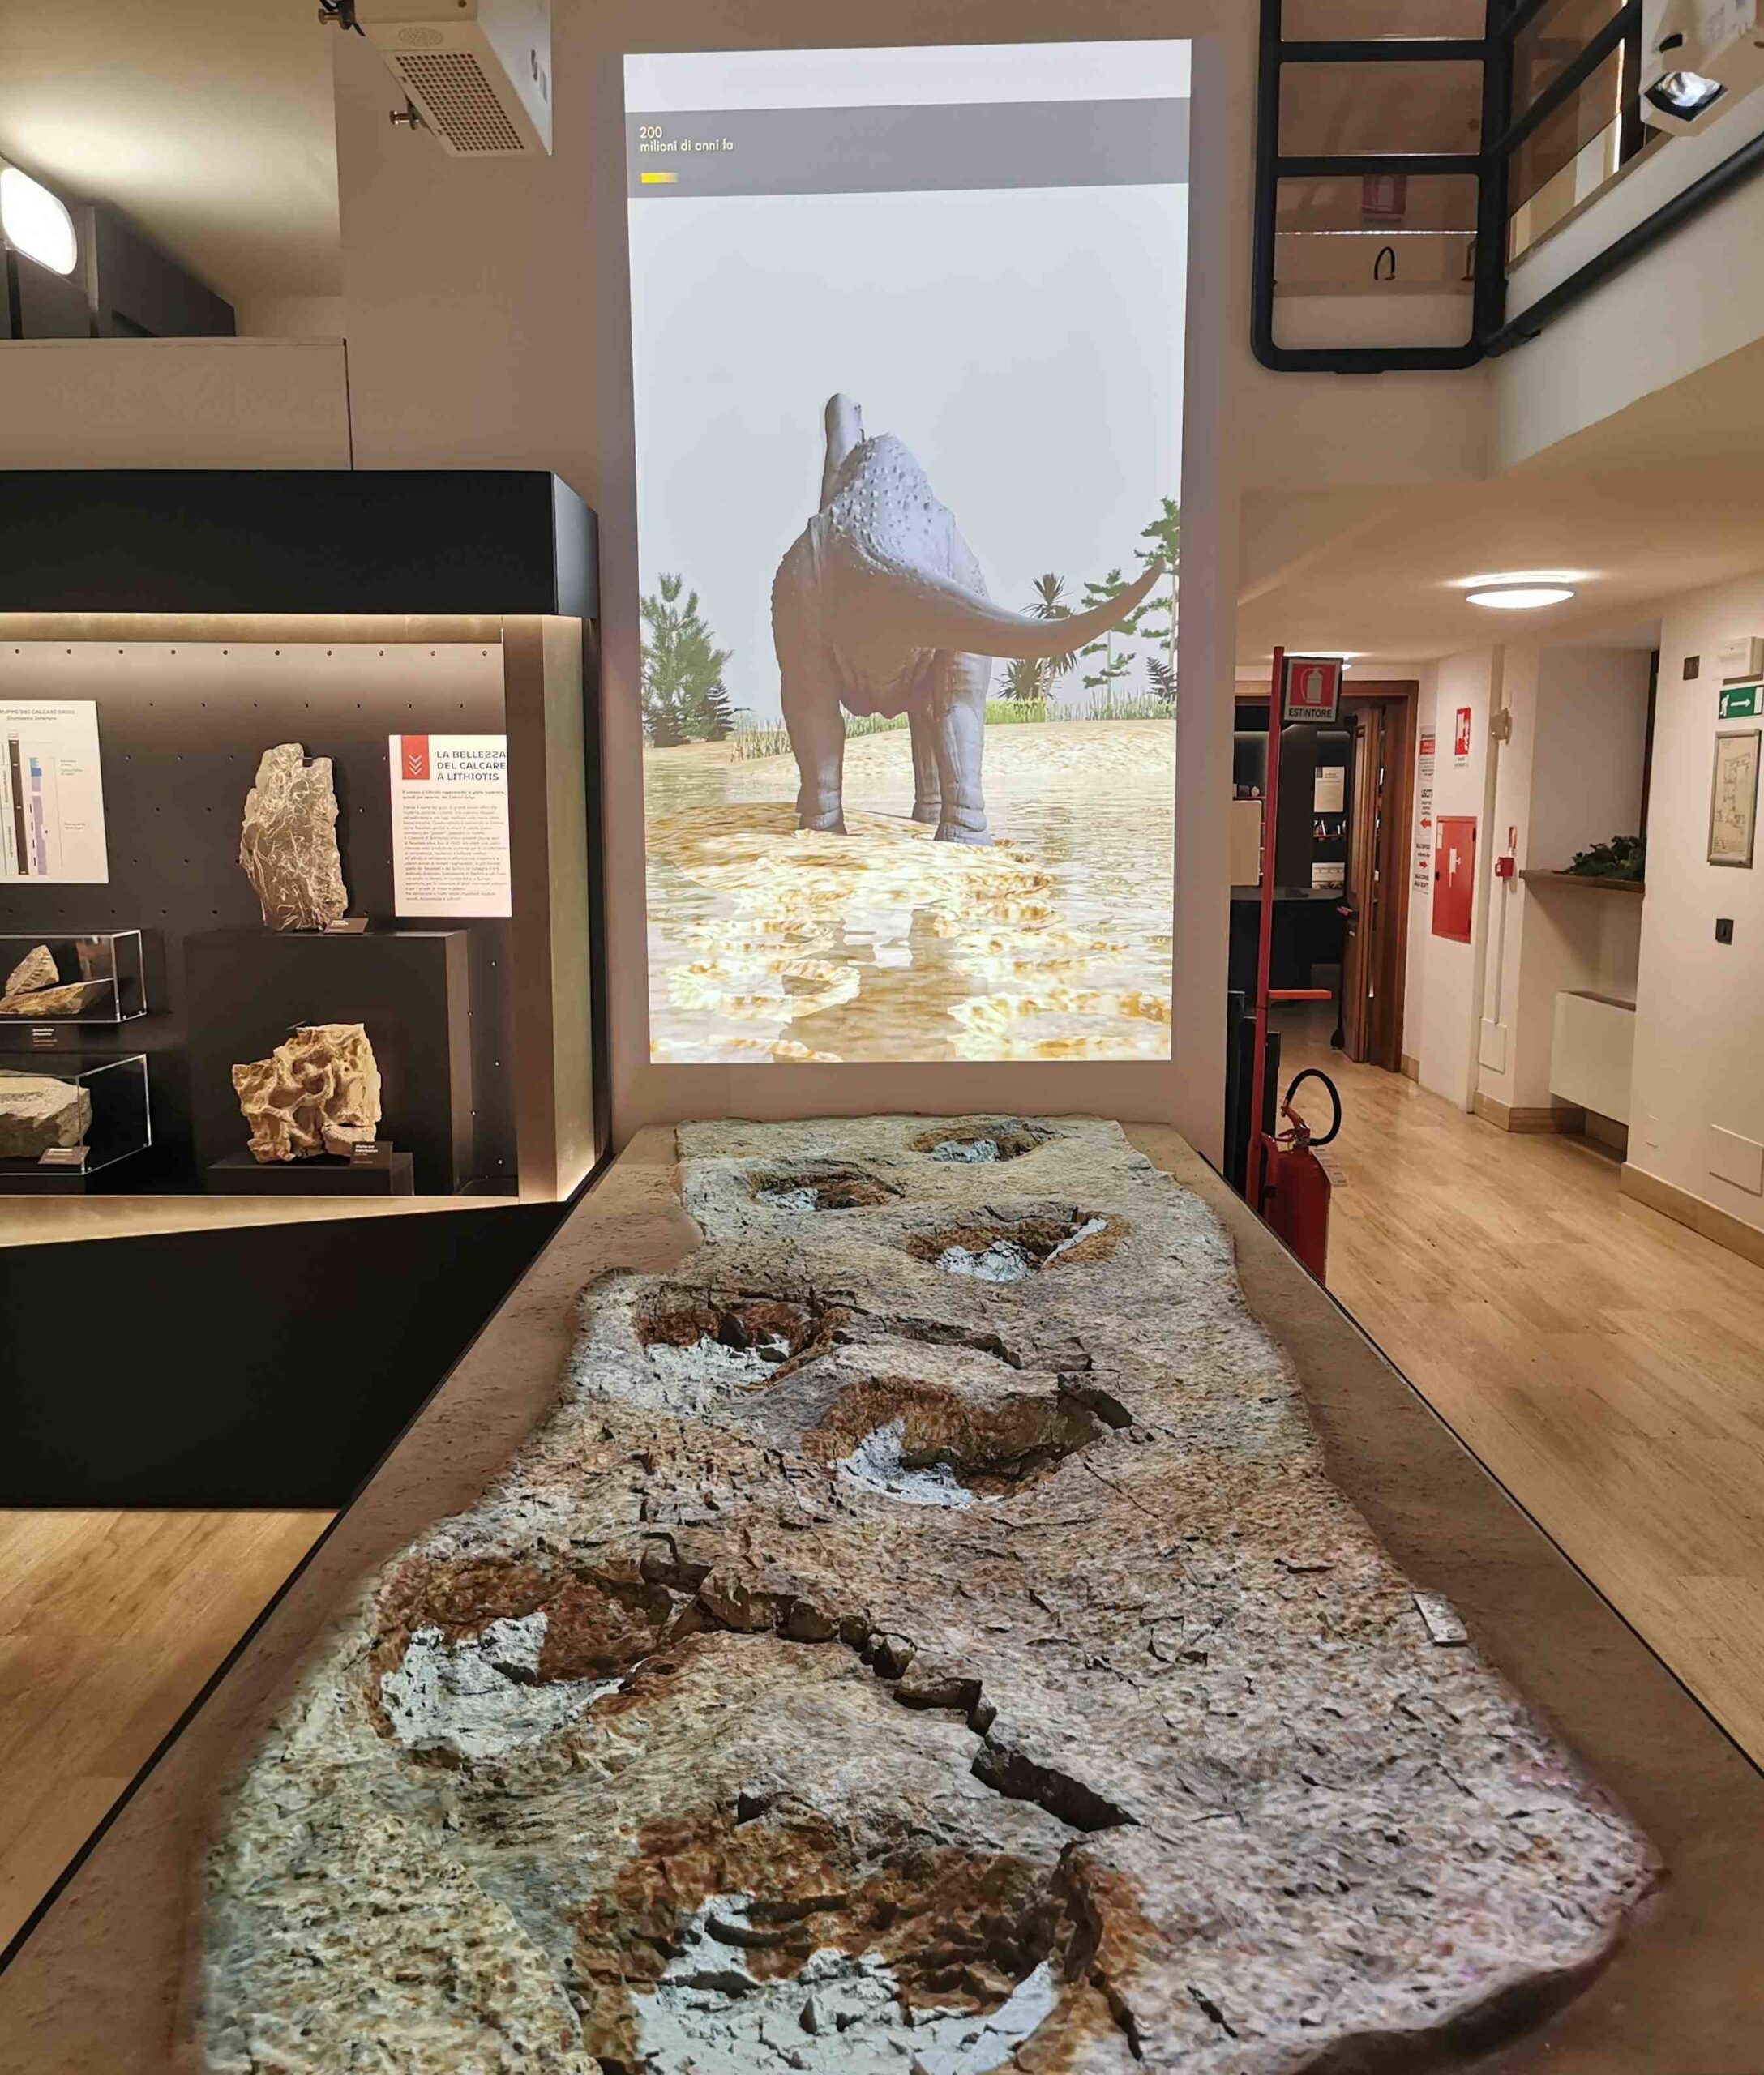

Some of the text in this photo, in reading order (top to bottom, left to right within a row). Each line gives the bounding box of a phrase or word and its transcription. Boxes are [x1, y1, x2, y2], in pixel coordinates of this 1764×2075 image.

[639, 126, 663, 139] 200
[640, 137, 734, 152] milioni di anni fa
[1289, 708, 1333, 718] ESTINTORE
[436, 751, 506, 759] LA BELLEZZA
[437, 762, 506, 770] DEL CALCARE
[437, 772, 499, 781] A LITHIOTIS
